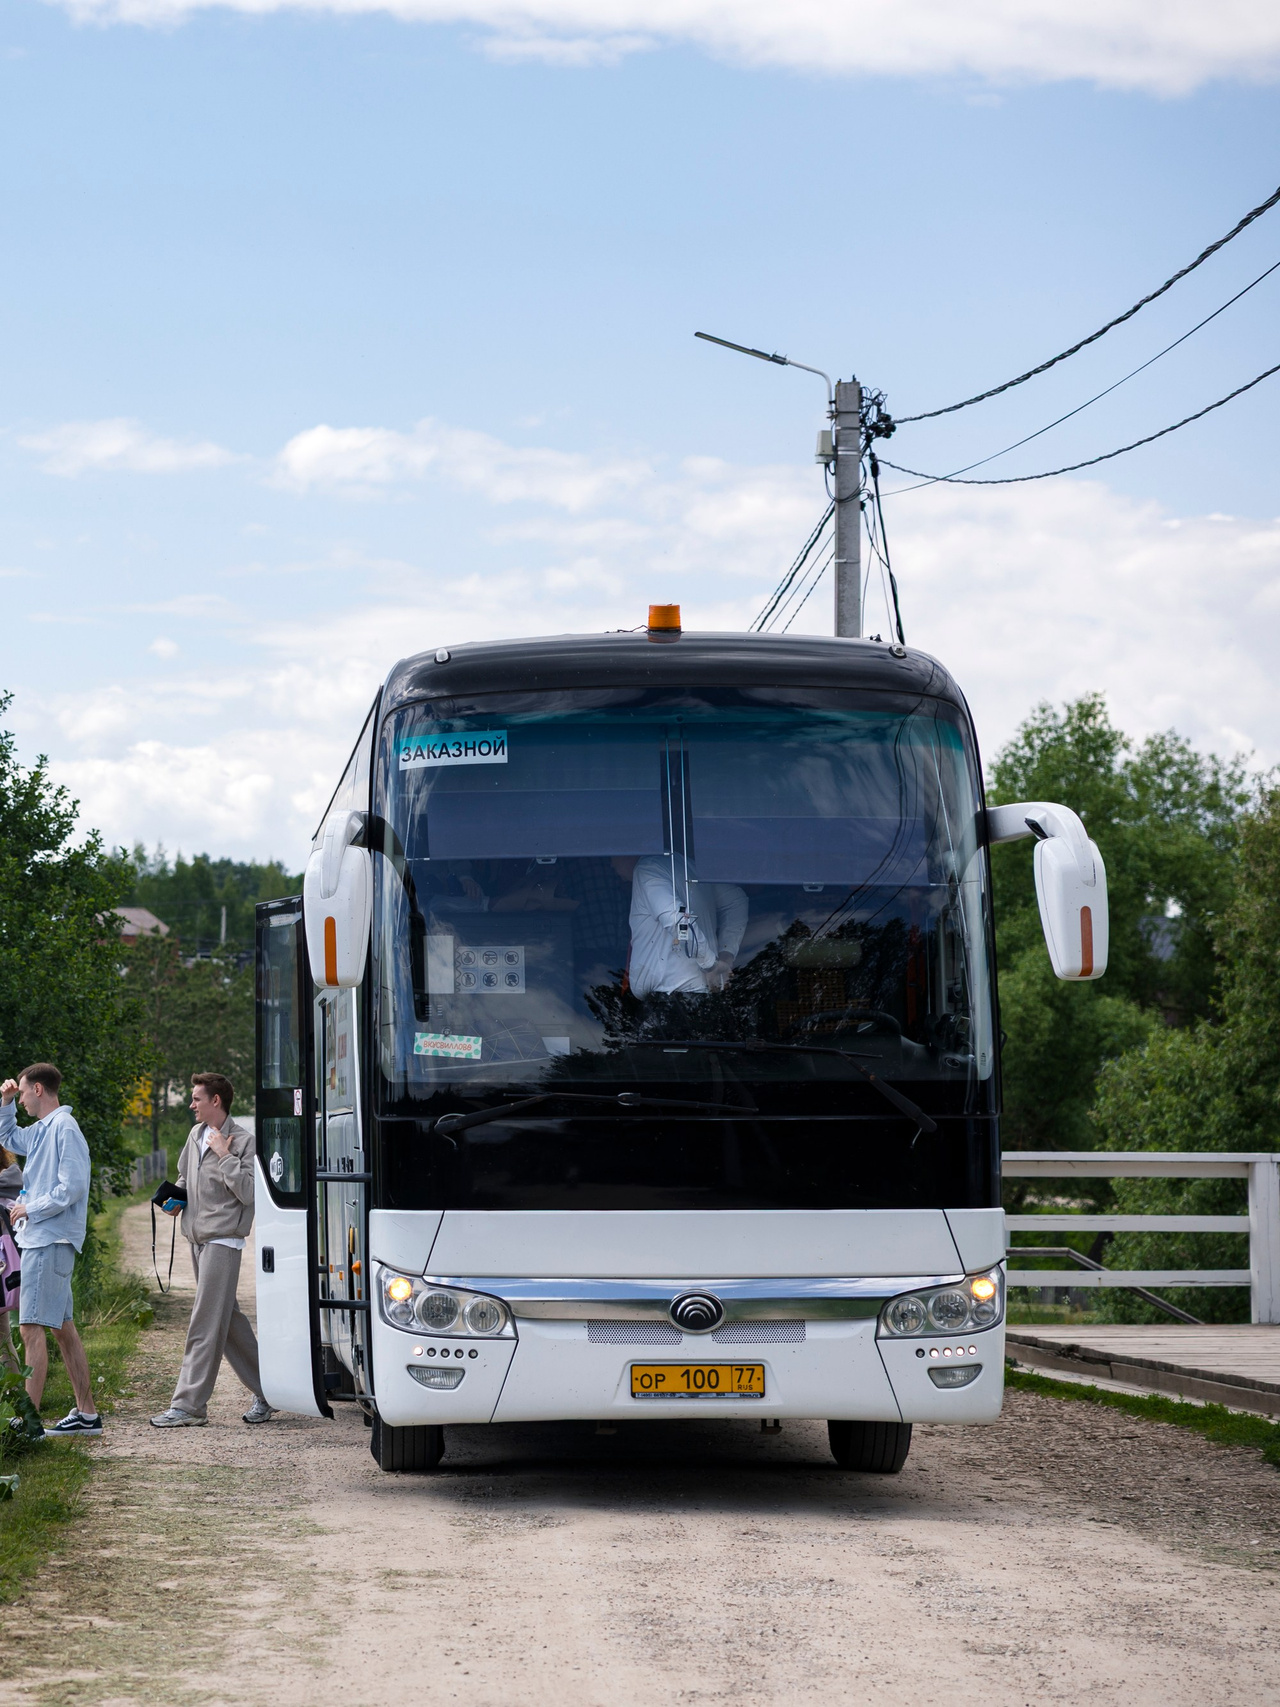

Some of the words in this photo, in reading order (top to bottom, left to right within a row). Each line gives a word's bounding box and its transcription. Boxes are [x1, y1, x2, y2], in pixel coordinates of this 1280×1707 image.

[401, 736, 505, 762] ЗАКАЗНОЙ
[680, 1369, 720, 1389] 100
[734, 1368, 755, 1383] 77
